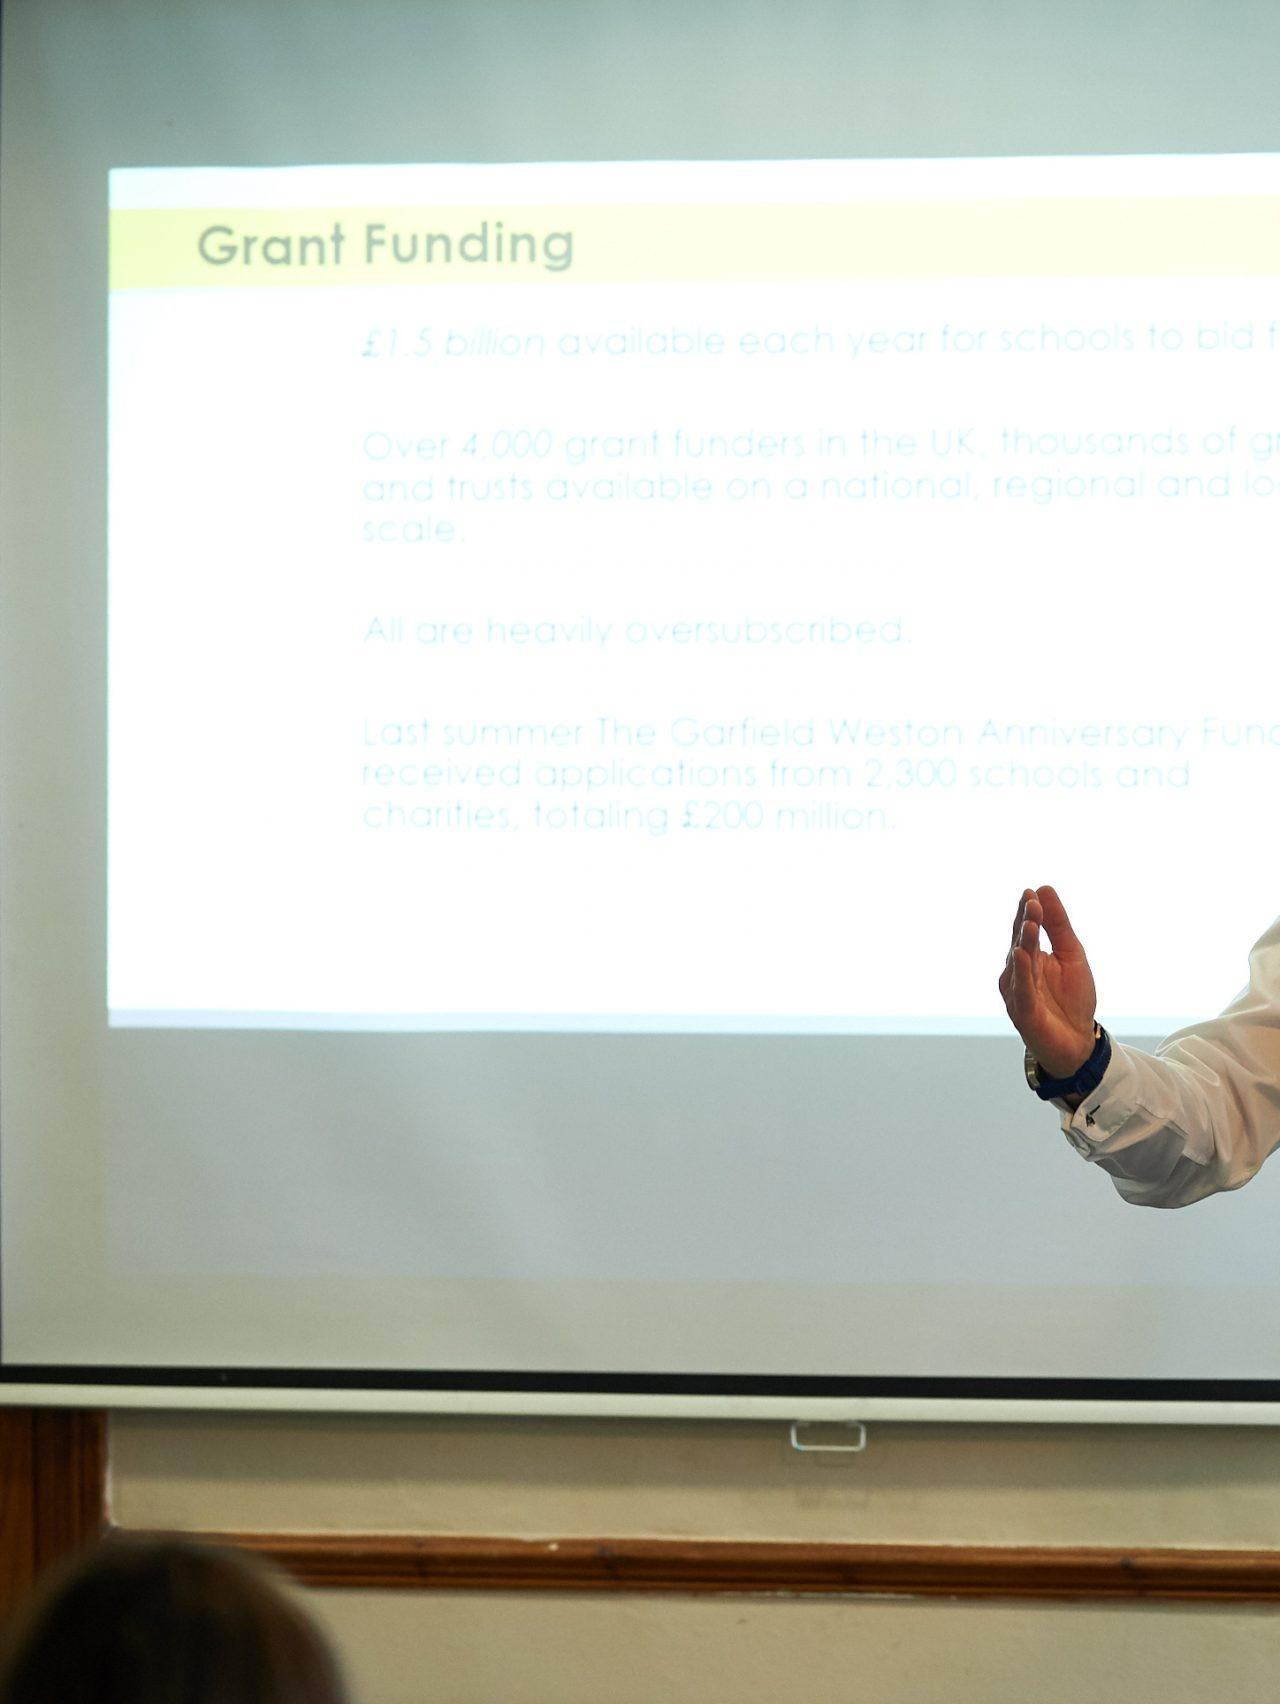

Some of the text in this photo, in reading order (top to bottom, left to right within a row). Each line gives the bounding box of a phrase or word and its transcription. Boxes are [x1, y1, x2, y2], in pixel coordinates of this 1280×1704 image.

[197, 221, 574, 273] Grant Funding
[444, 327, 546, 359] billion
[557, 327, 726, 358] available
[738, 325, 834, 357] each
[848, 331, 930, 359] year
[940, 324, 988, 353] for
[1000, 323, 1135, 352] schools
[1147, 323, 1184, 352] to
[1196, 320, 1254, 350] bid
[362, 431, 449, 461] Over
[564, 431, 661, 467] grant
[673, 427, 805, 459] funders
[817, 429, 848, 456] in
[859, 429, 918, 458] the
[1001, 426, 1190, 456] thousands
[1201, 424, 1238, 456] of
[361, 477, 434, 503] and
[447, 473, 534, 503] trusts
[545, 473, 713, 502] available
[726, 476, 772, 501] on
[784, 476, 809, 501] a
[821, 471, 977, 501] national,
[993, 469, 1146, 506] regional
[1156, 471, 1232, 498] and
[363, 616, 404, 643] All
[416, 622, 473, 646] are
[486, 616, 613, 650] heavily
[361, 719, 430, 748] Last
[442, 721, 583, 748] summer
[595, 716, 657, 748] The
[670, 715, 815, 750] Garfield
[829, 719, 965, 749] Weston
[976, 719, 1188, 752] Anniversary
[361, 756, 1191, 792] received applications from 2,300 schools and
[362, 800, 519, 832] charities,
[534, 800, 670, 837] totaling
[681, 799, 764, 831] £200
